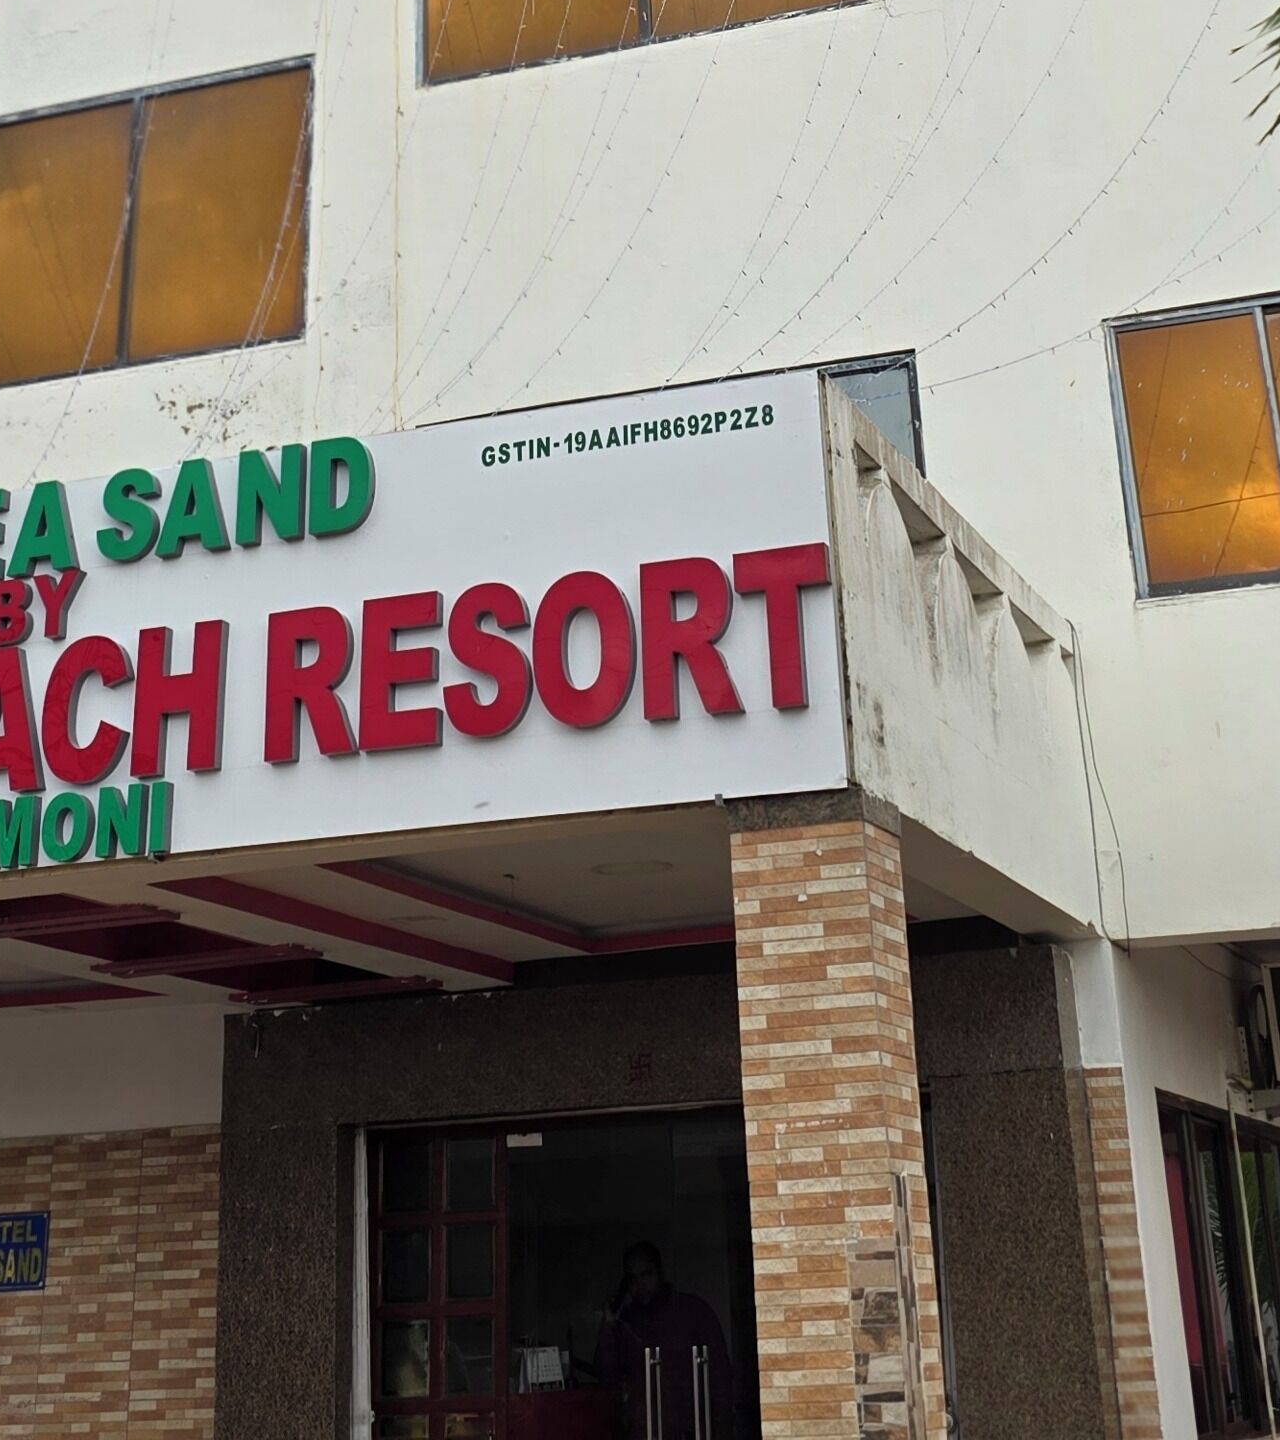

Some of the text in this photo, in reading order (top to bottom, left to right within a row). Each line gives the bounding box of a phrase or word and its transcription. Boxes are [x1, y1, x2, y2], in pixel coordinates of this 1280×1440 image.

[481, 404, 775, 467] GSTIN-19AAIFH8692P2Z8
[96, 436, 377, 562] SAND
[264, 542, 832, 765] RESORT
